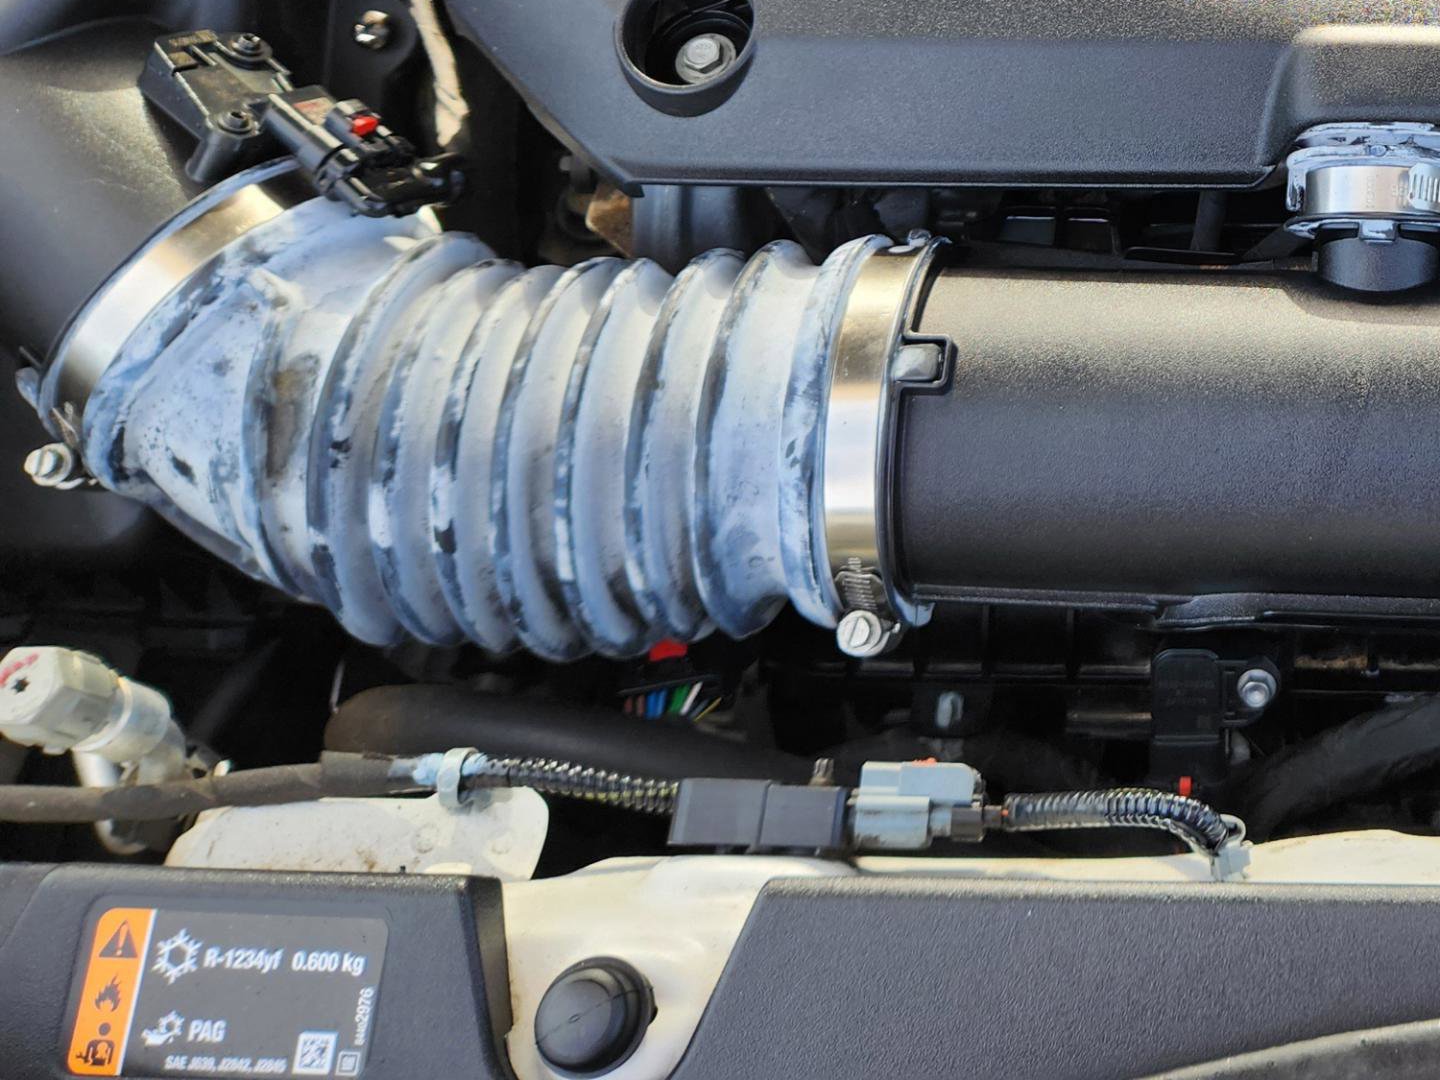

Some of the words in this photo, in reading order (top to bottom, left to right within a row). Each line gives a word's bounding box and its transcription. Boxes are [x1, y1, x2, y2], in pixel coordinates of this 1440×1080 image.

[203, 946, 284, 974] R-1234yf
[291, 949, 339, 971] 0.600
[341, 951, 367, 977] kg
[187, 1020, 226, 1043] PAG
[164, 1055, 188, 1070] SAE
